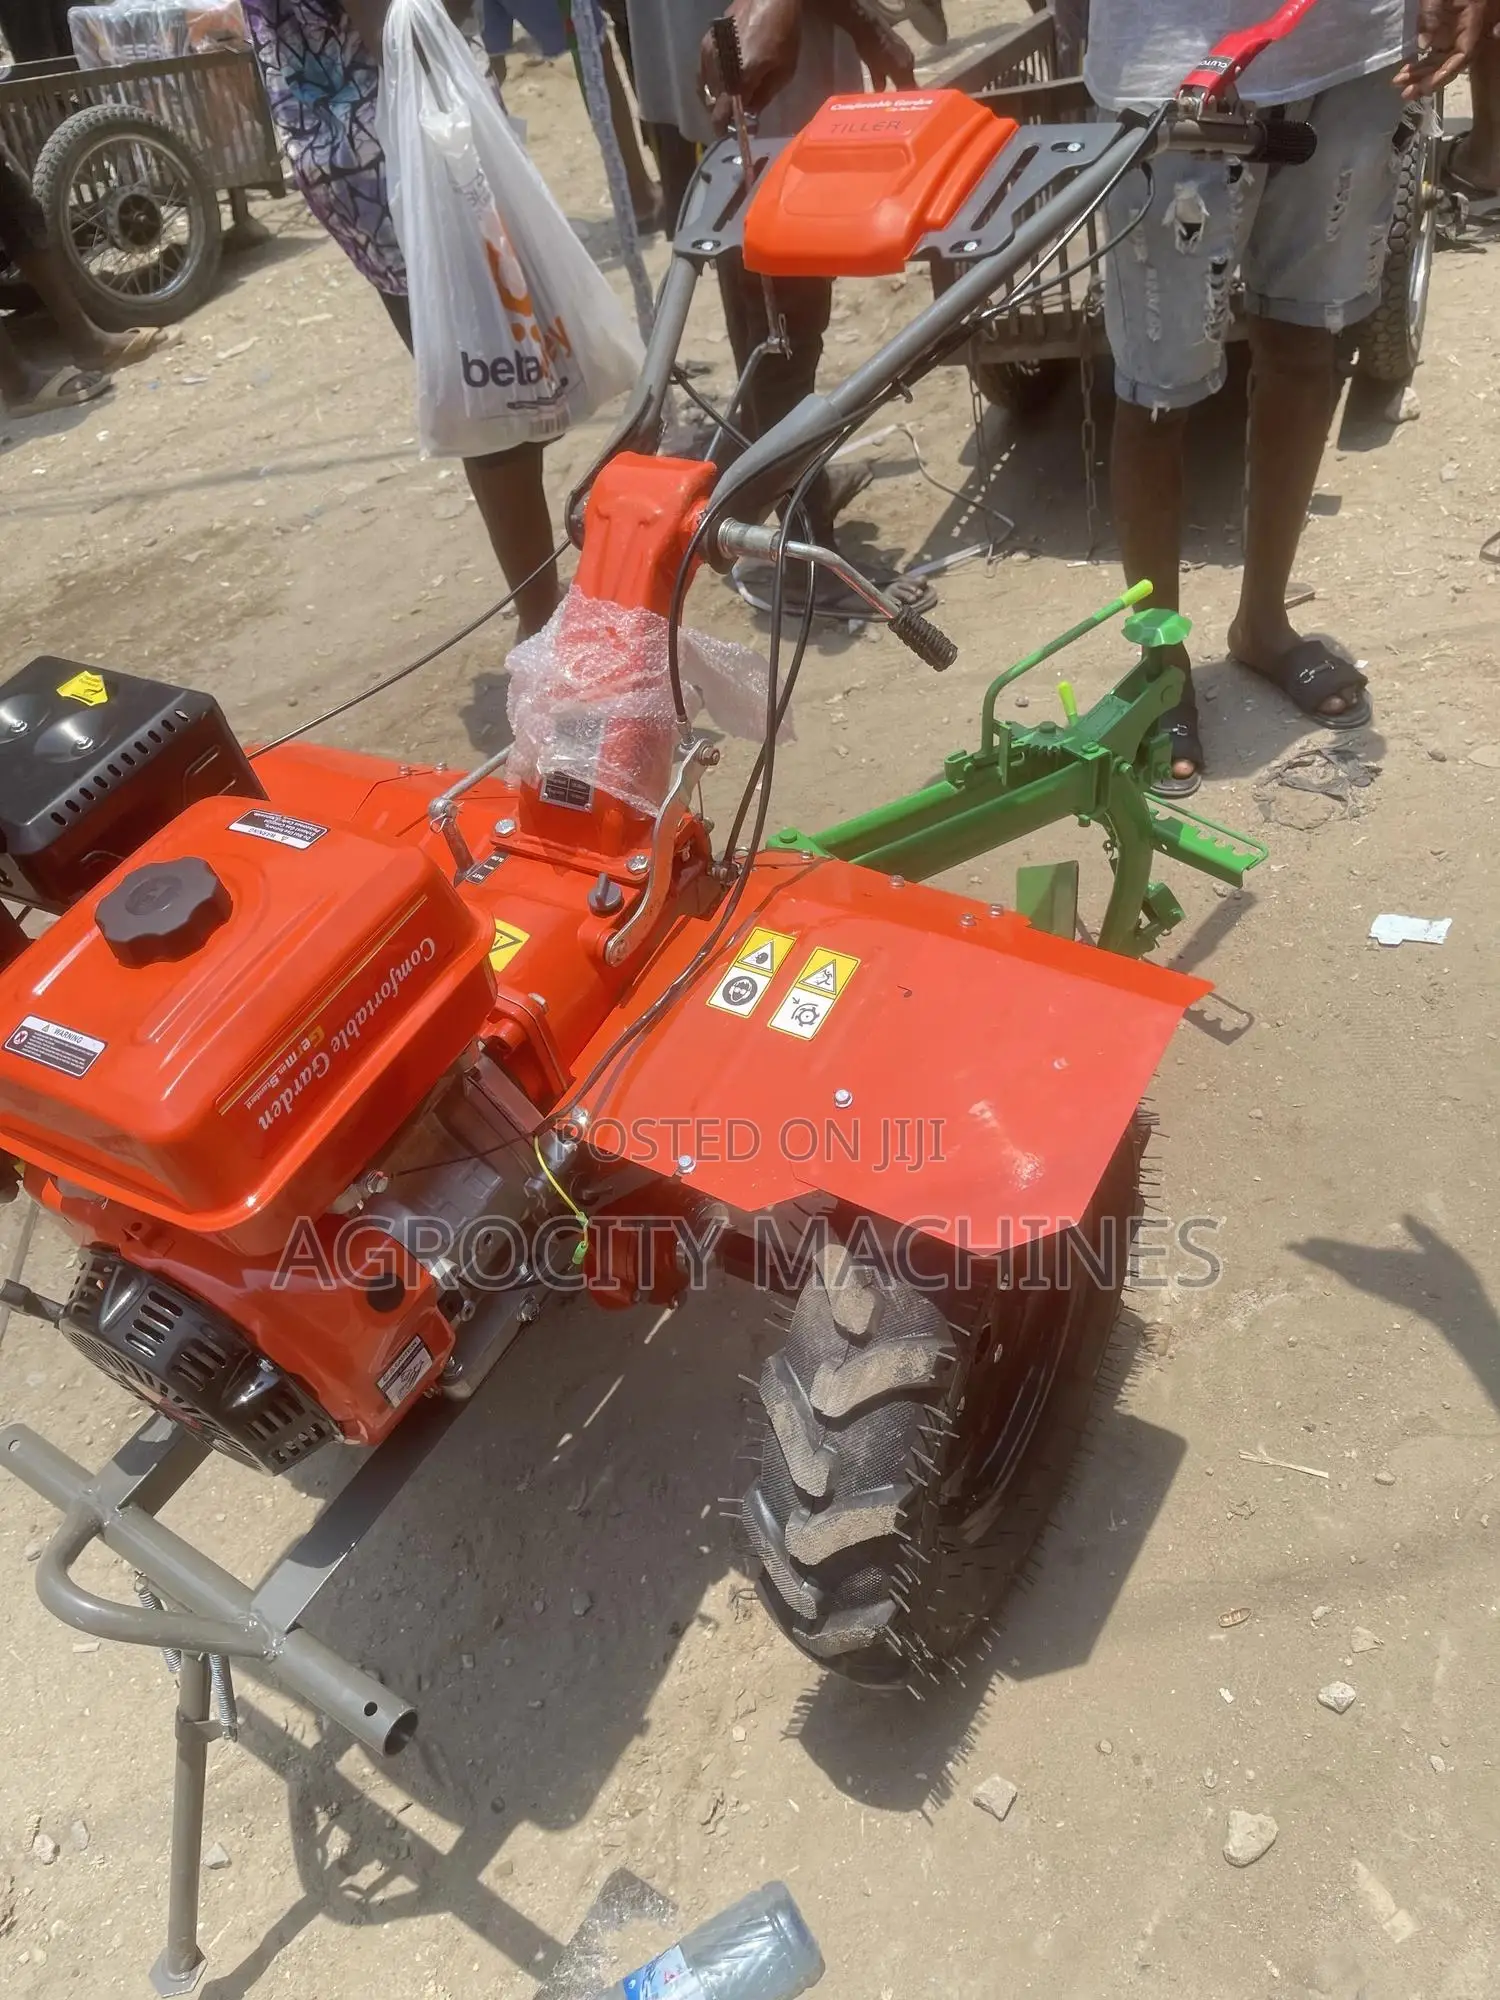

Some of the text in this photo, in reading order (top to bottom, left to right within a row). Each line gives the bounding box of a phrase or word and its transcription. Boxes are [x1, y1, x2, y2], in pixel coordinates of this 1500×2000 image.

[1200, 60, 1228, 68] CLUTC
[831, 121, 902, 134] TILLER
[54, 1028, 83, 1044] WARNING
[258, 937, 436, 1130] Comfortable Garden
[278, 1025, 325, 1074] German
